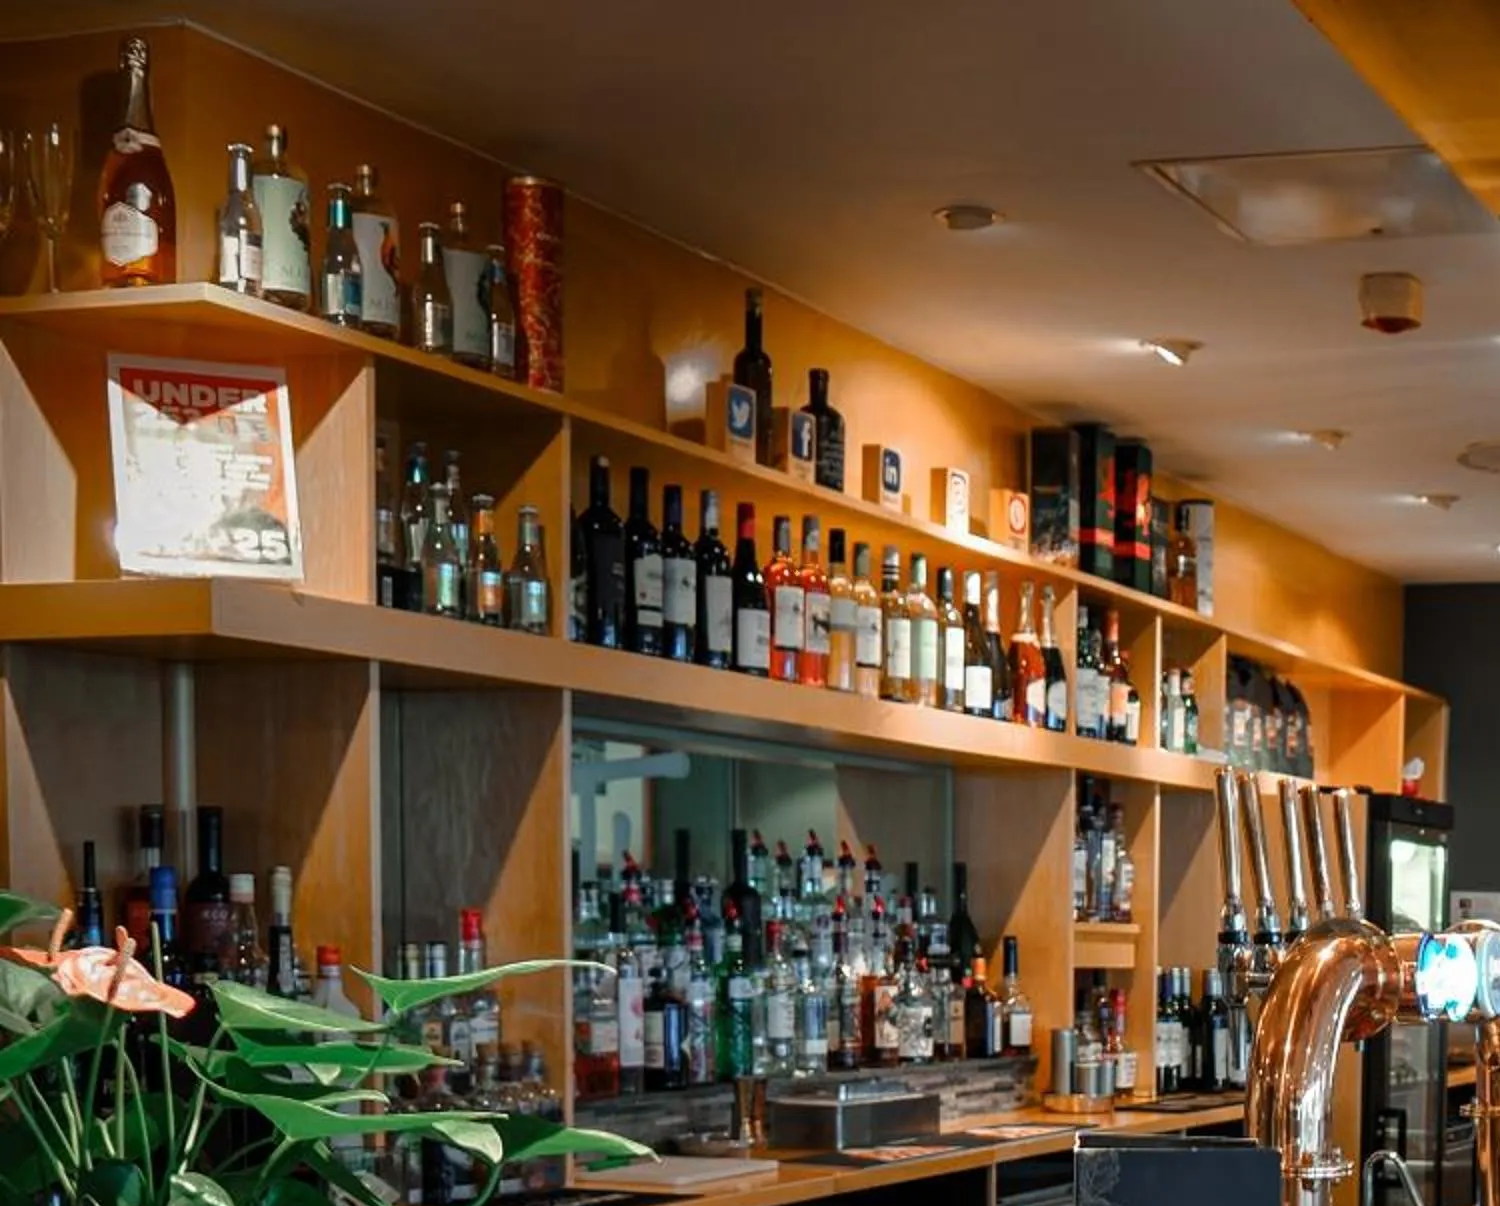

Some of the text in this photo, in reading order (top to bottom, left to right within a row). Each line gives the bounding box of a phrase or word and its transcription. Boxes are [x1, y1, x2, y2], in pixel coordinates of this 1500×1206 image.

[131, 378, 268, 414] UNDER
[885, 457, 898, 484] in
[232, 528, 290, 560] 25
